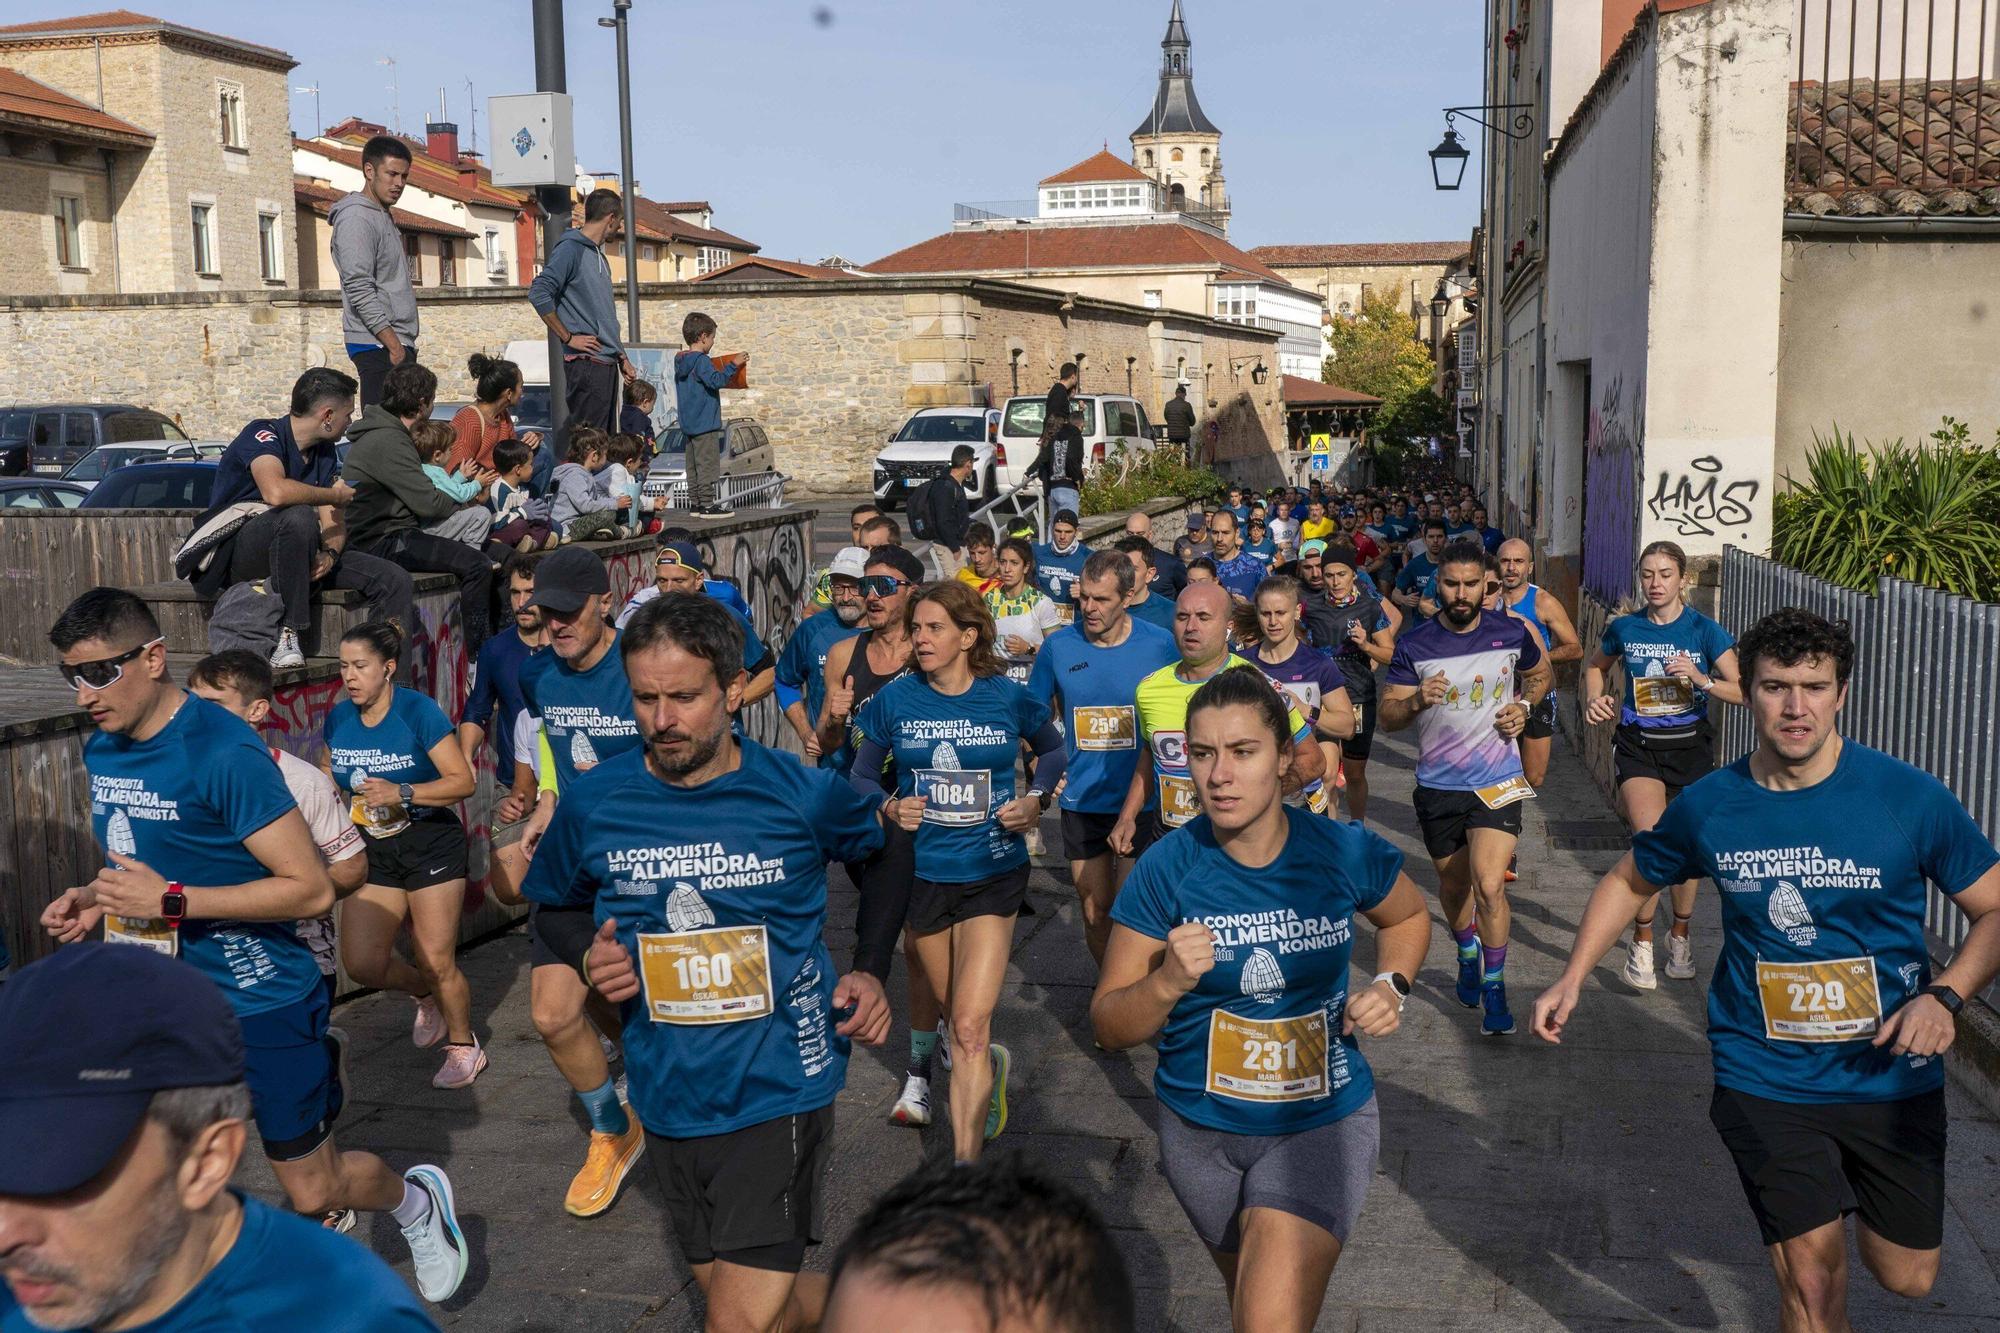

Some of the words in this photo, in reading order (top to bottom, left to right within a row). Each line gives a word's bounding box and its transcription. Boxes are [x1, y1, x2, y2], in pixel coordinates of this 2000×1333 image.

[1632, 643, 1676, 651] CONQUISTA
[1069, 662, 1089, 674] HOKA
[544, 706, 552, 714] LA
[552, 706, 601, 717] CONQUISTA
[554, 715, 622, 727] ALMENDRA
[901, 720, 912, 729] LA
[913, 719, 972, 730] CONQUISTA
[1089, 717, 1119, 735] 259
[587, 727, 639, 737] KONKISTA
[914, 725, 994, 739] ALMENDRA
[956, 736, 1008, 747] KONKISTA
[336, 753, 399, 766] ALMENDRA
[337, 749, 382, 757] CONQUISTA
[368, 760, 416, 773] KONKISTA
[98, 776, 144, 790] CONQUISTA
[94, 787, 160, 808] ALMENDRA
[160, 800, 178, 809] REN
[929, 783, 976, 806] 1084
[127, 806, 181, 821] KONKISTA
[607, 851, 625, 863] LA
[626, 842, 725, 863] CONQUISTA
[1716, 852, 1733, 864] LA
[1733, 847, 1824, 865] CONQUISTA
[609, 864, 620, 872] DE
[621, 863, 633, 872] LA
[632, 853, 762, 881] ALMENDRA
[762, 858, 784, 870] REN
[1718, 863, 1728, 871] DE
[1729, 863, 1740, 871] LA
[1738, 859, 1858, 880] ALMENDRA
[1859, 867, 1881, 877] REN
[701, 868, 786, 891] KONKISTA
[1802, 876, 1883, 889] KONKISTA
[1203, 908, 1299, 930] CONQUISTA
[1210, 916, 1334, 947] ALMENDRA
[1334, 918, 1349, 931] REN
[1786, 926, 1816, 935] VITORIA
[741, 934, 758, 945] 10K
[1279, 929, 1351, 955] KONKISTA
[672, 953, 733, 990] 160
[1851, 965, 1867, 975] 10K
[1787, 981, 1847, 1012] 229
[1307, 1021, 1321, 1031] 10K
[1243, 1039, 1297, 1071] 231
[1257, 1072, 1283, 1081] MARÍA
